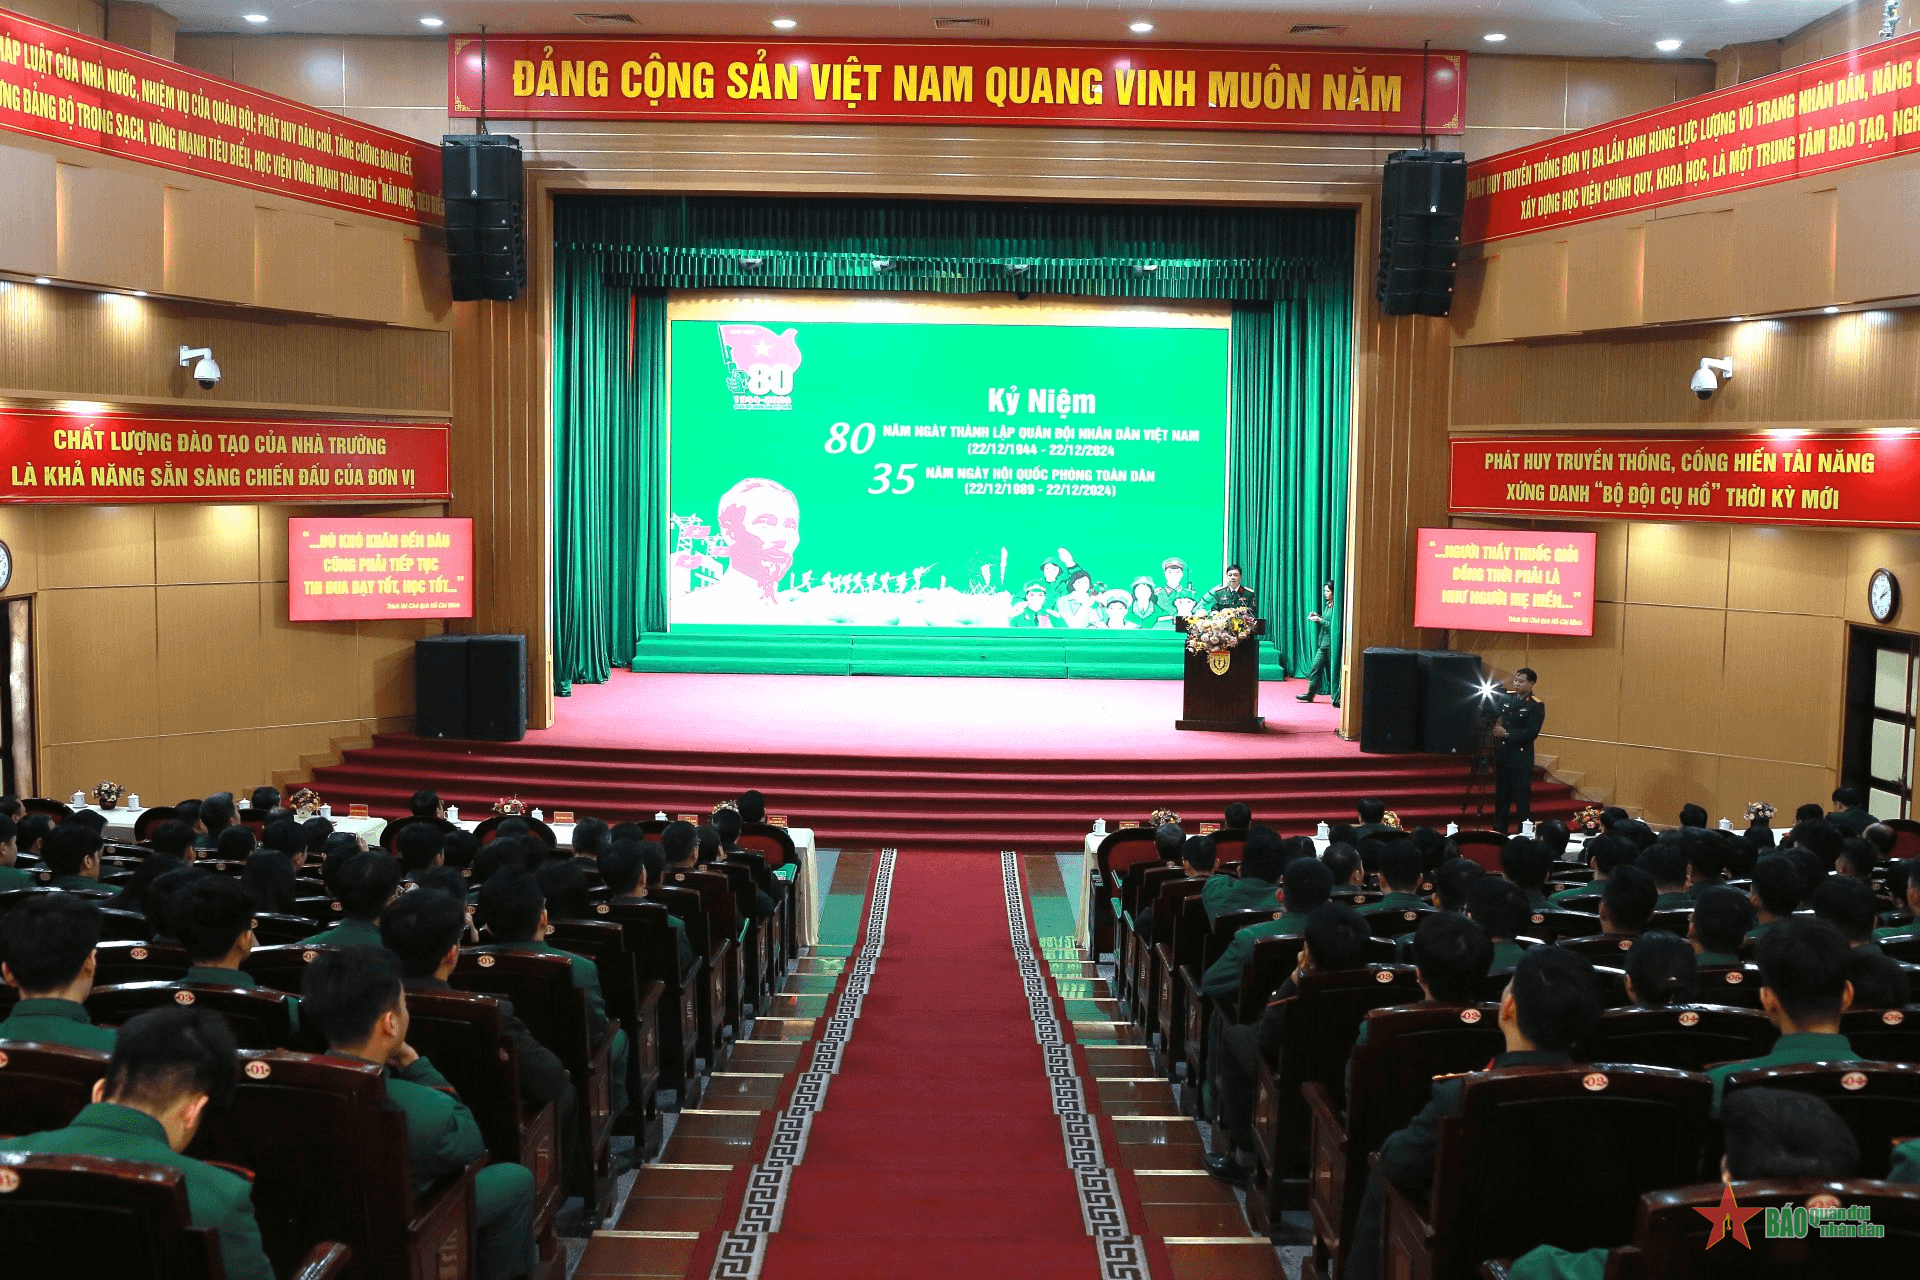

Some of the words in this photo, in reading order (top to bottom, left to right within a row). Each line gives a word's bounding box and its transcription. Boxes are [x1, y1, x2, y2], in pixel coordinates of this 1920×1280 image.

[512, 45, 609, 97] ĐẢNG
[621, 52, 715, 106] CỘNG
[726, 48, 798, 100] SẢN
[810, 55, 882, 109] VIỆT
[893, 64, 973, 103] NAM
[985, 66, 1103, 106] QUANG
[1115, 67, 1196, 108] VINH
[1208, 63, 1311, 111] MUÔN
[1322, 66, 1401, 112] NĂM
[24, 42, 53, 79] LUẬT
[55, 46, 79, 83] CỦA
[81, 60, 105, 90] NHÀ
[107, 67, 140, 103] NƯỚC,
[142, 78, 175, 112] NHIỆM
[176, 88, 189, 118] VỤ
[191, 87, 211, 120] CỦA
[212, 98, 237, 128] QUÂN
[239, 104, 257, 136] ĐỘI;
[257, 112, 280, 139] PHÁT
[280, 119, 298, 144] HUY
[298, 122, 315, 149] DÂN
[316, 126, 334, 157] CHỦ,
[335, 133, 354, 160] TĂNG
[355, 140, 380, 167] CƯỜNG
[380, 147, 399, 173] ĐOÀN
[23, 81, 57, 121] ĐẢNG
[59, 94, 75, 131] BỘ
[76, 102, 114, 135] TRONG
[115, 112, 147, 146] SẠCH,
[149, 118, 176, 150] VỮNG
[178, 129, 207, 160] MẠNH
[208, 134, 228, 164] TIÊU
[230, 137, 253, 173] BIỂU,
[254, 149, 272, 178] HỌC
[273, 152, 292, 183] VIỆN
[293, 157, 315, 185] VỮNG
[316, 165, 339, 192] MẠNH
[339, 170, 359, 196] TOÀN
[360, 175, 377, 203] DIỆN
[1486, 172, 1502, 195] HUY
[1502, 159, 1532, 191] TRUYỀN
[1533, 152, 1560, 183] THỐNG
[1561, 151, 1580, 176] ĐƠN
[1581, 149, 1591, 175] VỊ
[1592, 145, 1604, 169] BA
[1606, 134, 1625, 165] LẦN
[1626, 134, 1647, 160] ANH
[1648, 125, 1676, 154] HÙNG
[1678, 119, 1698, 149] LỰC
[1700, 109, 1736, 143] LƯỢNG
[1738, 100, 1754, 131] VŨ
[1756, 93, 1796, 126] TRANG
[1798, 80, 1835, 116] NHÂN
[1836, 71, 1869, 106] DÂN,
[1872, 60, 1913, 97] NÂNG
[1520, 195, 1537, 220] XÂY
[1537, 192, 1560, 220] DỰNG
[1561, 187, 1580, 214] HỌC
[1581, 180, 1601, 210] VIỆN
[1603, 173, 1632, 202] CHÍNH
[1633, 169, 1654, 198] QUY,
[1656, 162, 1683, 191] KHOA
[1685, 157, 1710, 187] HỌC,
[1712, 148, 1726, 178] LÀ
[1728, 142, 1754, 177] MỘT
[1756, 135, 1796, 168] TRUNG
[1798, 125, 1826, 158] TÂM
[1828, 118, 1856, 152] ĐÀO
[1858, 113, 1889, 149] TẠO,
[988, 384, 1020, 416] Kỷ
[1028, 388, 1096, 419] Niệm
[53, 423, 105, 450] CHẤT
[110, 429, 172, 456] LƯỢNG
[177, 430, 213, 453] ĐÀO
[217, 434, 250, 457] TẠO
[254, 429, 288, 454] CỦA
[291, 432, 325, 454] NHÀ
[327, 433, 387, 455] TRƯỜNG
[824, 421, 876, 455] 80
[882, 423, 911, 437] NĂM
[914, 423, 947, 438] NGÀY
[950, 423, 989, 439] THÀNH
[992, 424, 1015, 441] LẬP
[1018, 424, 1051, 440] QUÂN
[1054, 425, 1075, 442] ĐỘI
[1078, 425, 1112, 441] NHÂN
[1115, 426, 1141, 441] DÂN
[1143, 426, 1169, 443] VIỆT
[1171, 429, 1200, 442] NAM
[11, 461, 38, 486] LÀ
[44, 459, 86, 486] KHẢ
[91, 462, 145, 487] NĂNG
[151, 460, 188, 487] SẴN
[193, 463, 241, 487] SÀNG
[245, 462, 294, 486] CHIẾN
[298, 462, 330, 486] ĐẤU
[334, 462, 364, 486] CỦA
[367, 467, 398, 486] ĐƠN
[401, 468, 415, 489] VỊ
[1484, 450, 1520, 470] PHÁT
[1523, 453, 1552, 470] HUY
[1555, 447, 1613, 471] TRUYỀN
[1617, 446, 1676, 474] THỐNG,
[1681, 446, 1729, 472] CỐNG
[1733, 446, 1777, 473] HIẾN
[1782, 448, 1812, 473] TÀI
[1817, 448, 1875, 474] NĂNG
[867, 462, 919, 495] 35
[925, 464, 954, 479] NĂM
[957, 465, 990, 480] NGÀY
[992, 465, 1013, 483] HỘI
[1016, 465, 1049, 481] QUỐC
[1051, 466, 1093, 481] PHÒNG
[1096, 467, 1127, 482] TOÀN
[1130, 467, 1156, 482] DÂN
[1506, 480, 1545, 501] XỨNG
[1549, 484, 1590, 503] DANH
[1628, 482, 1655, 508] ĐỘI
[1660, 486, 1683, 509] CỤ
[1725, 483, 1766, 508] THỜI
[1771, 484, 1796, 509] KỲ
[1801, 485, 1840, 510] MỚI
[250, 1066, 265, 1075] 01
